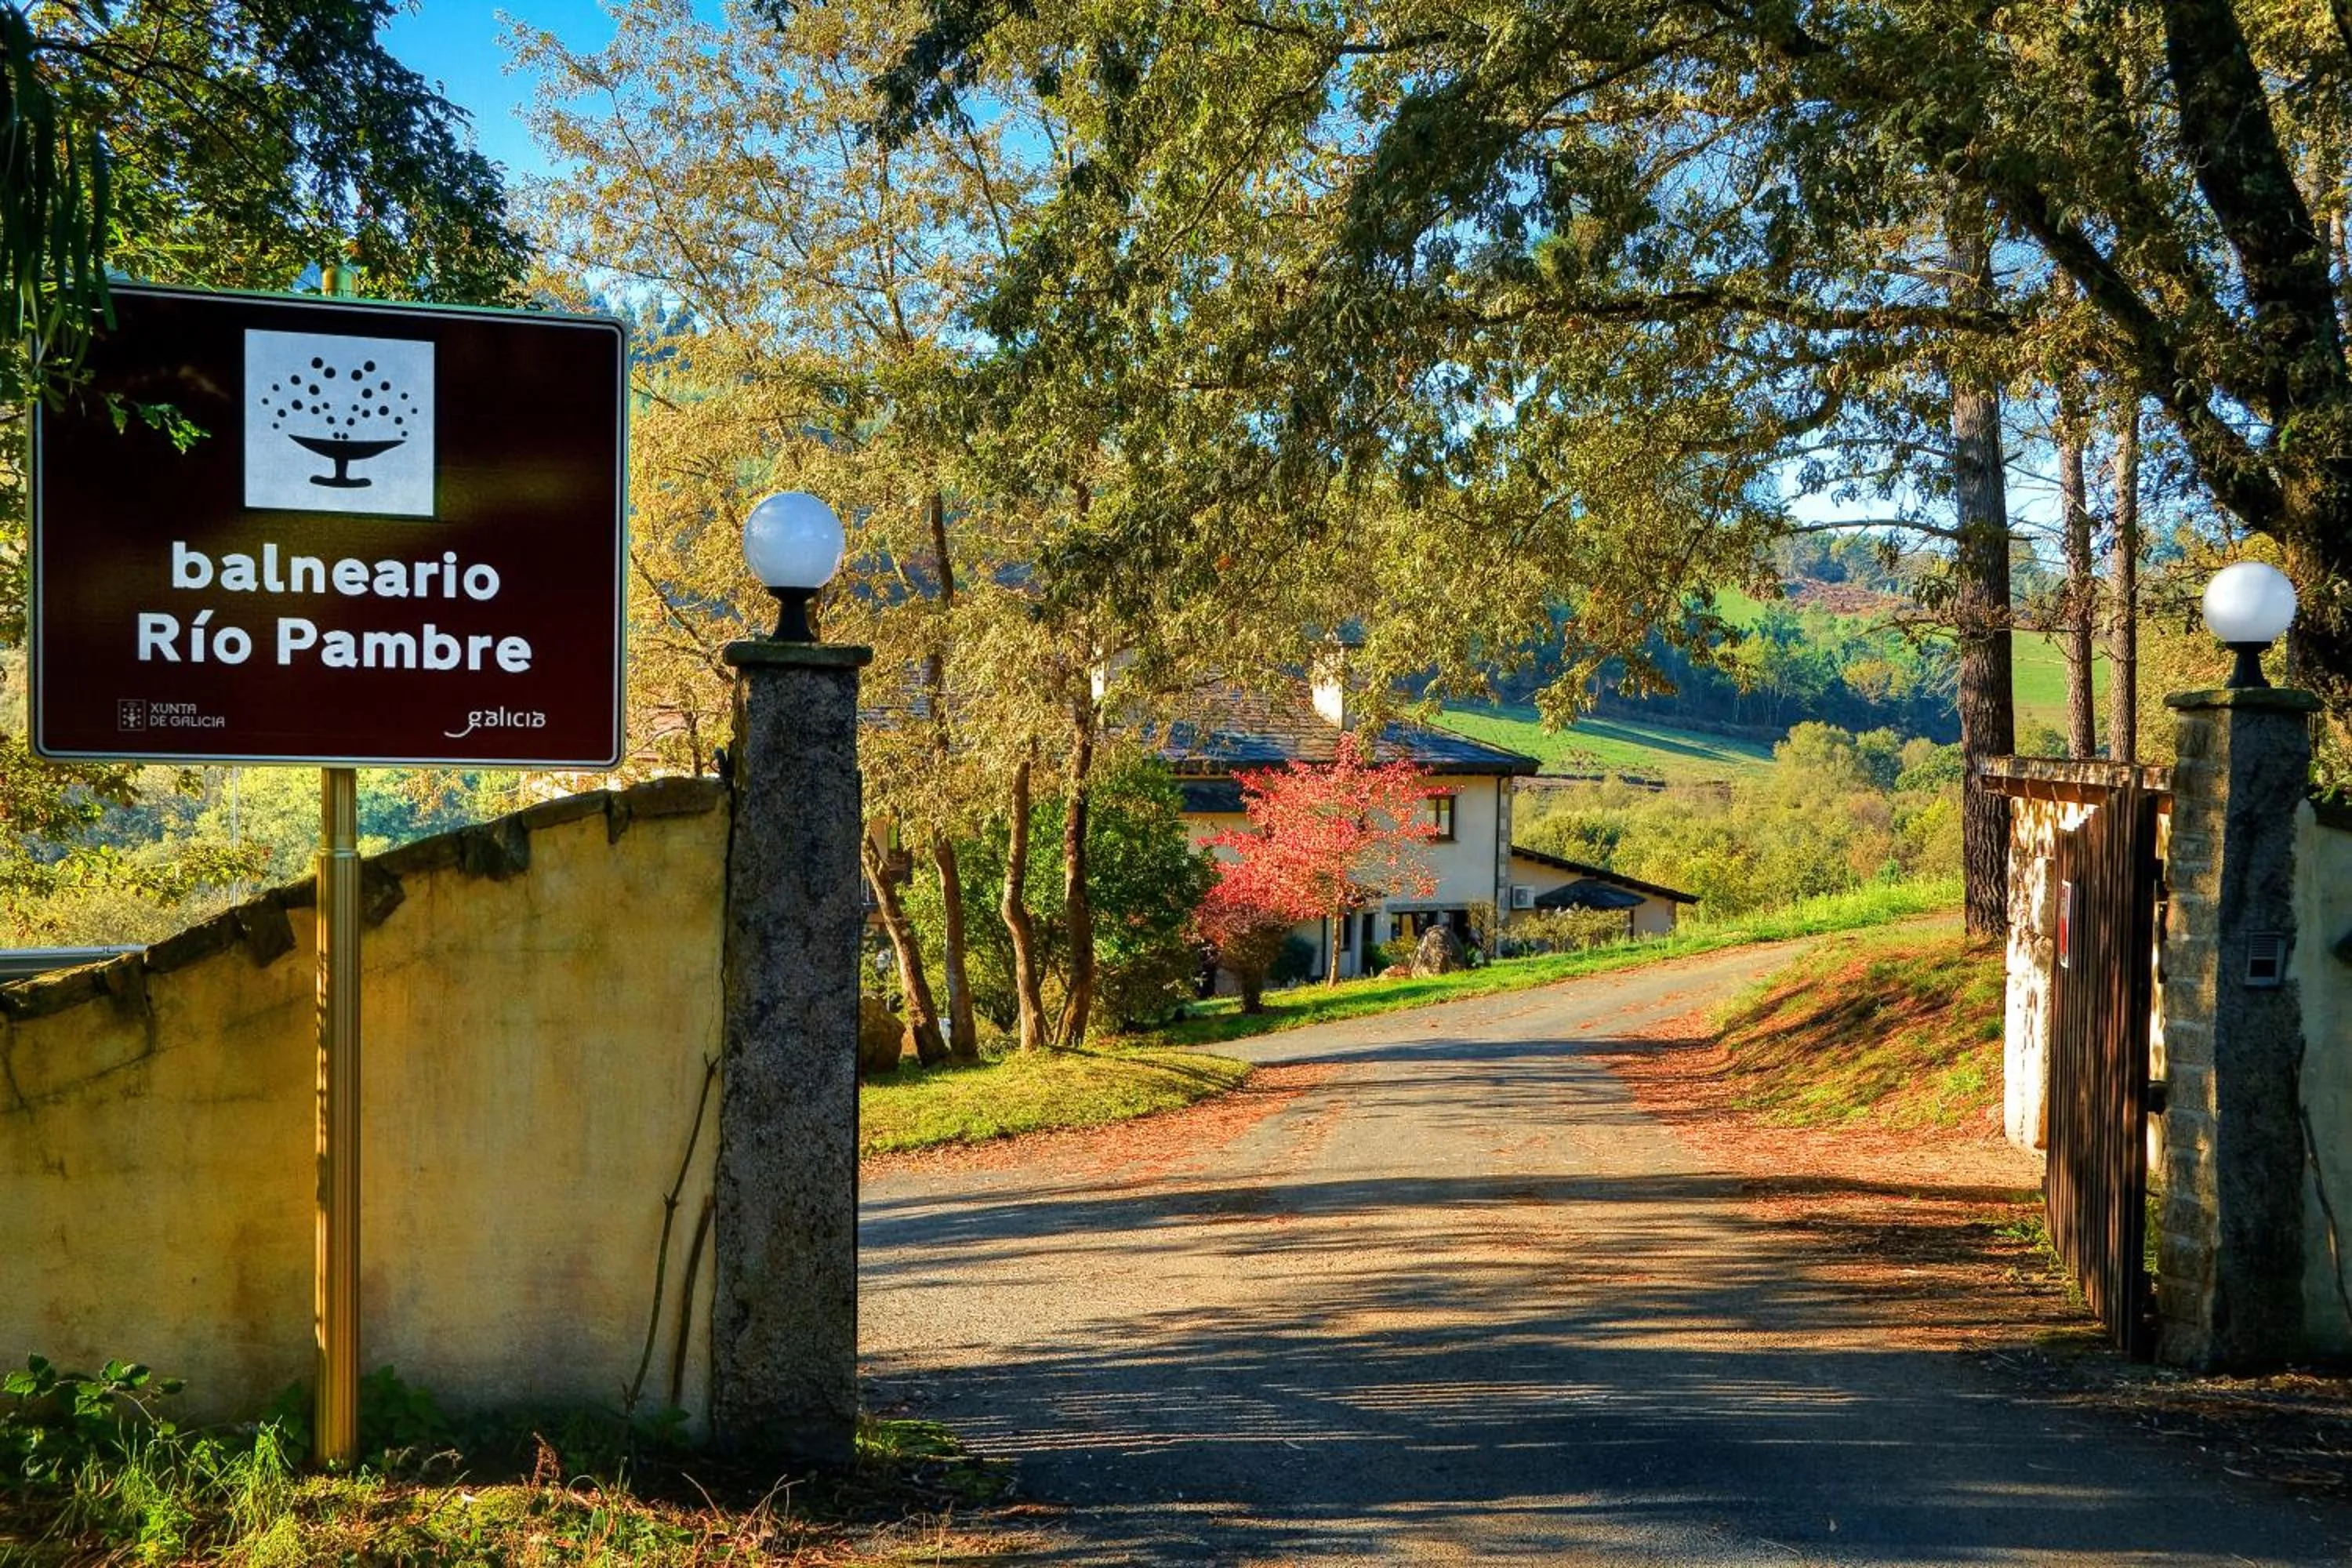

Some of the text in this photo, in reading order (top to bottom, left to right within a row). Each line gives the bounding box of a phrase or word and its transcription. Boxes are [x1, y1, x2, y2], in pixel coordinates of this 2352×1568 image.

[172, 540, 501, 601] balneario
[137, 609, 532, 673] Río Pambre
[150, 702, 198, 714] XUNTA
[150, 715, 226, 728] DE GALICIA
[444, 706, 546, 738] galicia
